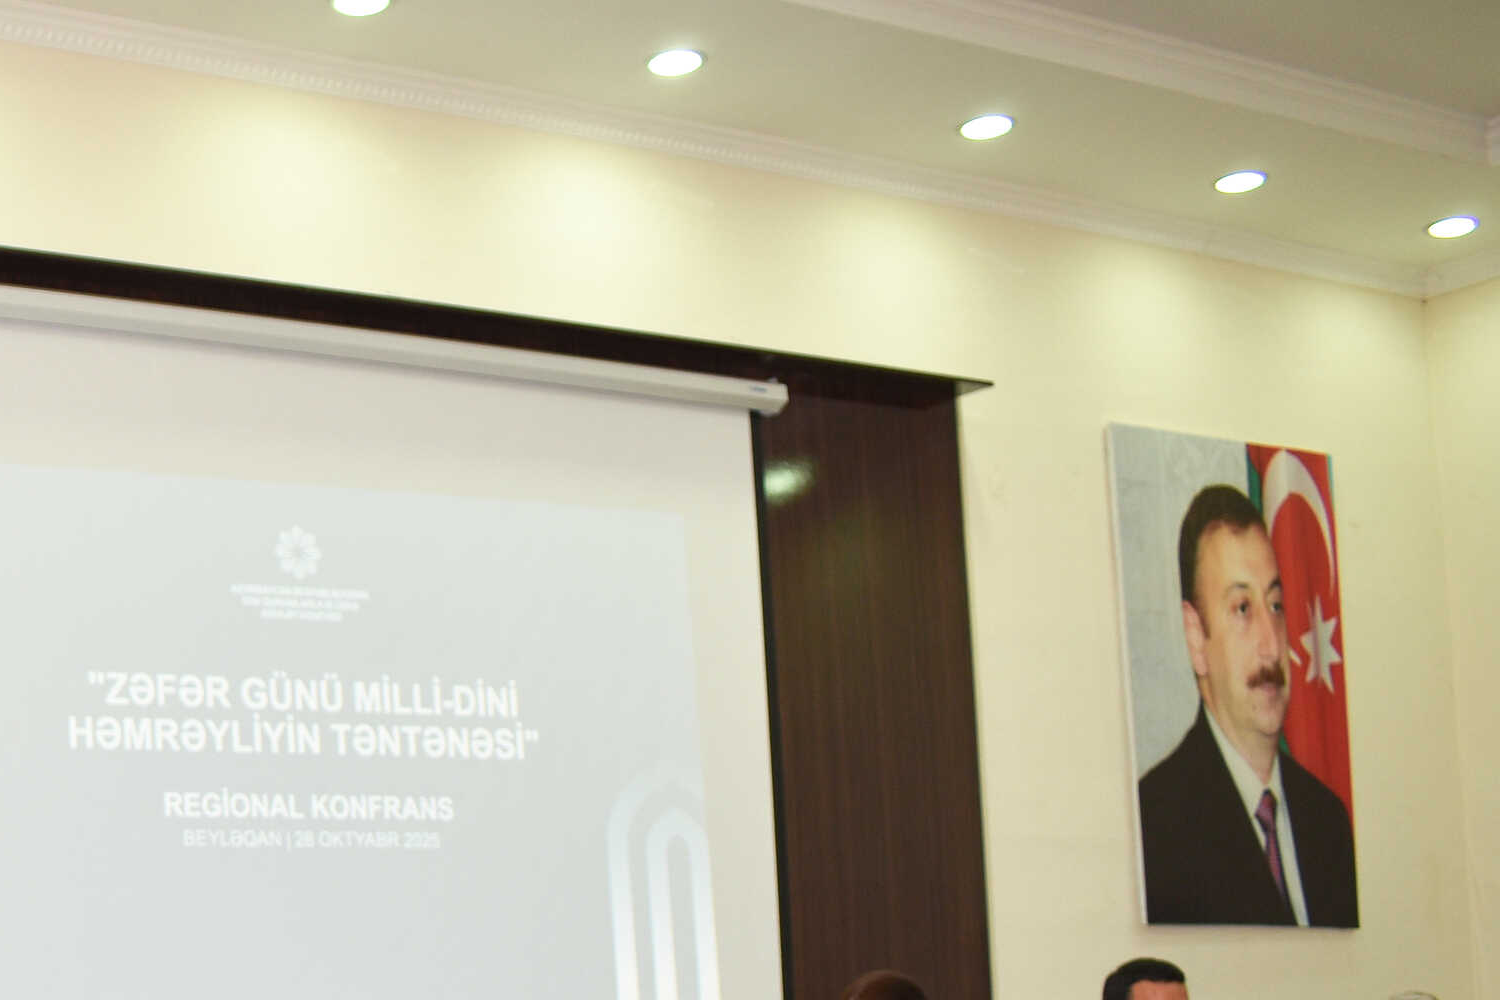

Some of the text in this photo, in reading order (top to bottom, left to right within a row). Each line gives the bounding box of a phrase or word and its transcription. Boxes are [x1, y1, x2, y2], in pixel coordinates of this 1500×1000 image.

[87, 669, 519, 718] "ZƏFƏR GÜNÜ MİLLİ-DİNİ
[68, 712, 539, 761] HƏMRƏYLİYİN TƏNTƏNƏSİ"
[163, 787, 454, 822] REGİONAL KONFRANS
[318, 830, 400, 849] OKTYABR
